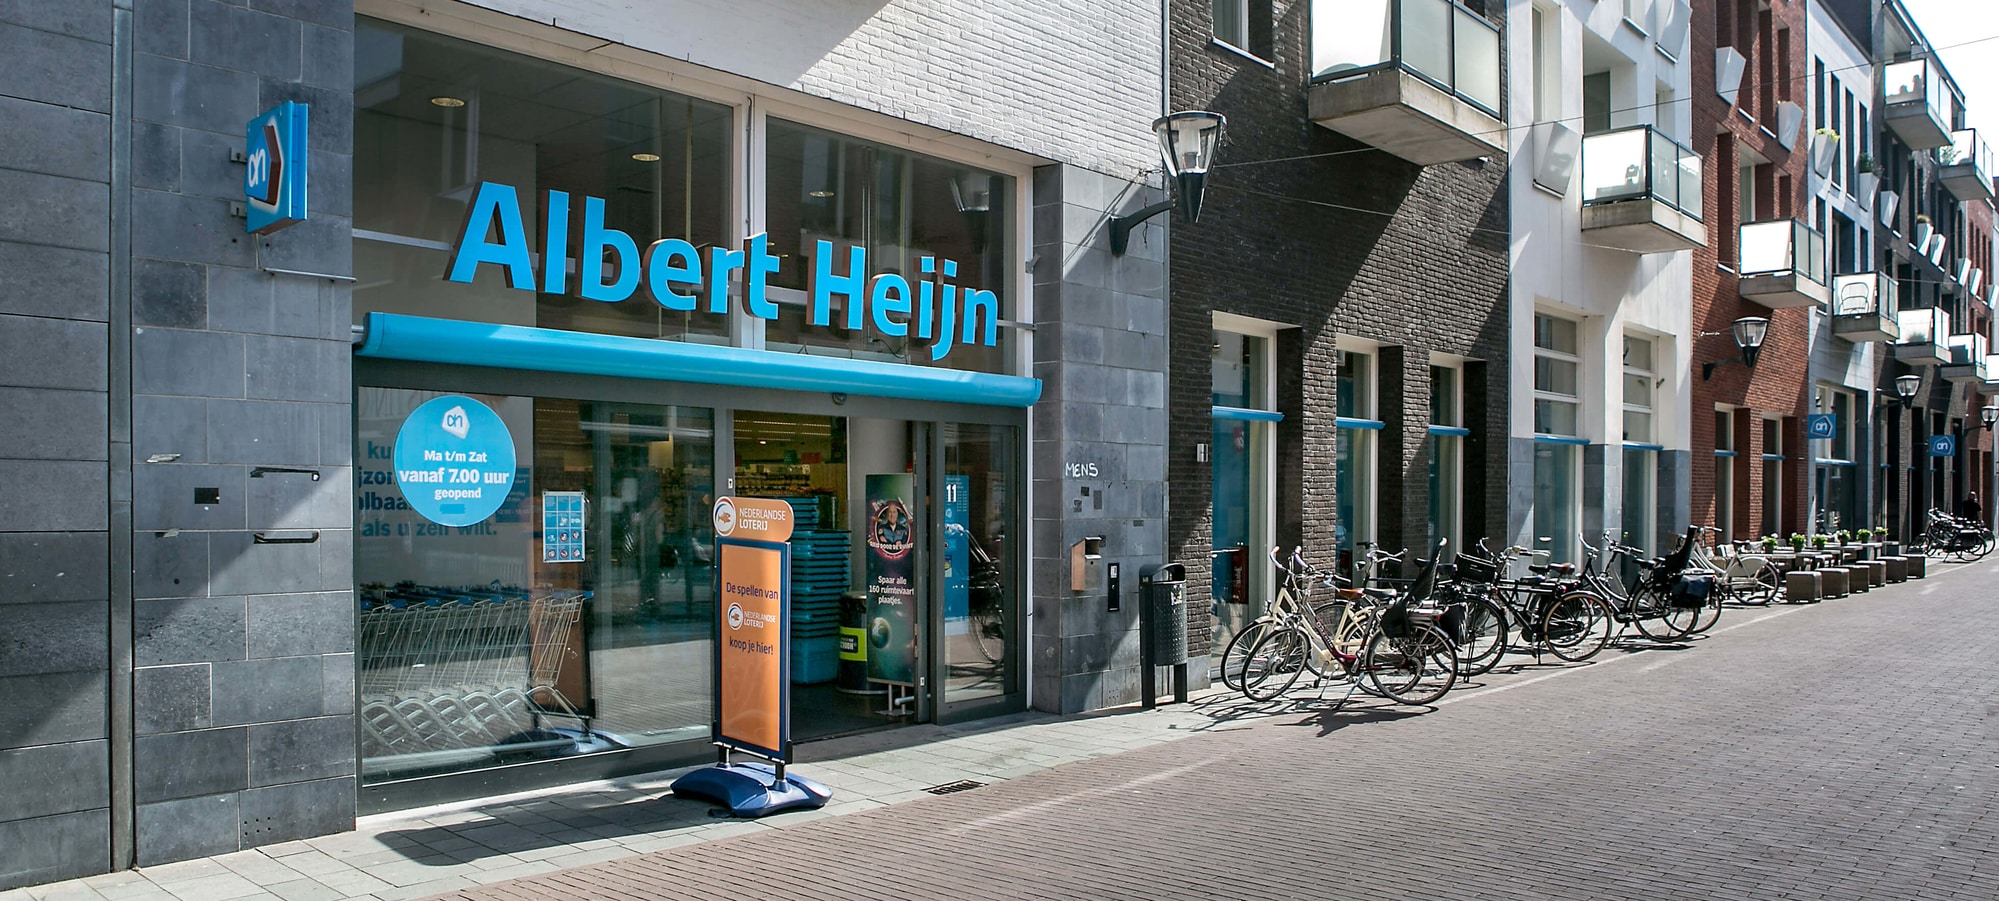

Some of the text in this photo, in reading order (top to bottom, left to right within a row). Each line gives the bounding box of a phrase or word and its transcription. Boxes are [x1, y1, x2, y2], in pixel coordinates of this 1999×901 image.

[443, 181, 999, 360] Albert Heijn
[424, 450, 488, 463] Ma t/m Zat
[399, 467, 510, 485] vanaf 7.00 uur
[1065, 462, 1099, 477] MENS
[434, 487, 482, 501] geopend
[946, 484, 957, 503] 11
[739, 507, 786, 521] NEDERLANDSE
[361, 519, 391, 537] als
[739, 518, 769, 531] LOTERIJ
[878, 575, 907, 586] Spaar alle
[726, 582, 779, 600] De spellen van
[881, 585, 915, 596] ruimtevaart
[878, 594, 902, 606] plaatjes.
[743, 610, 776, 623] NEDERLANDSE
[729, 635, 774, 655] koop je hier!
